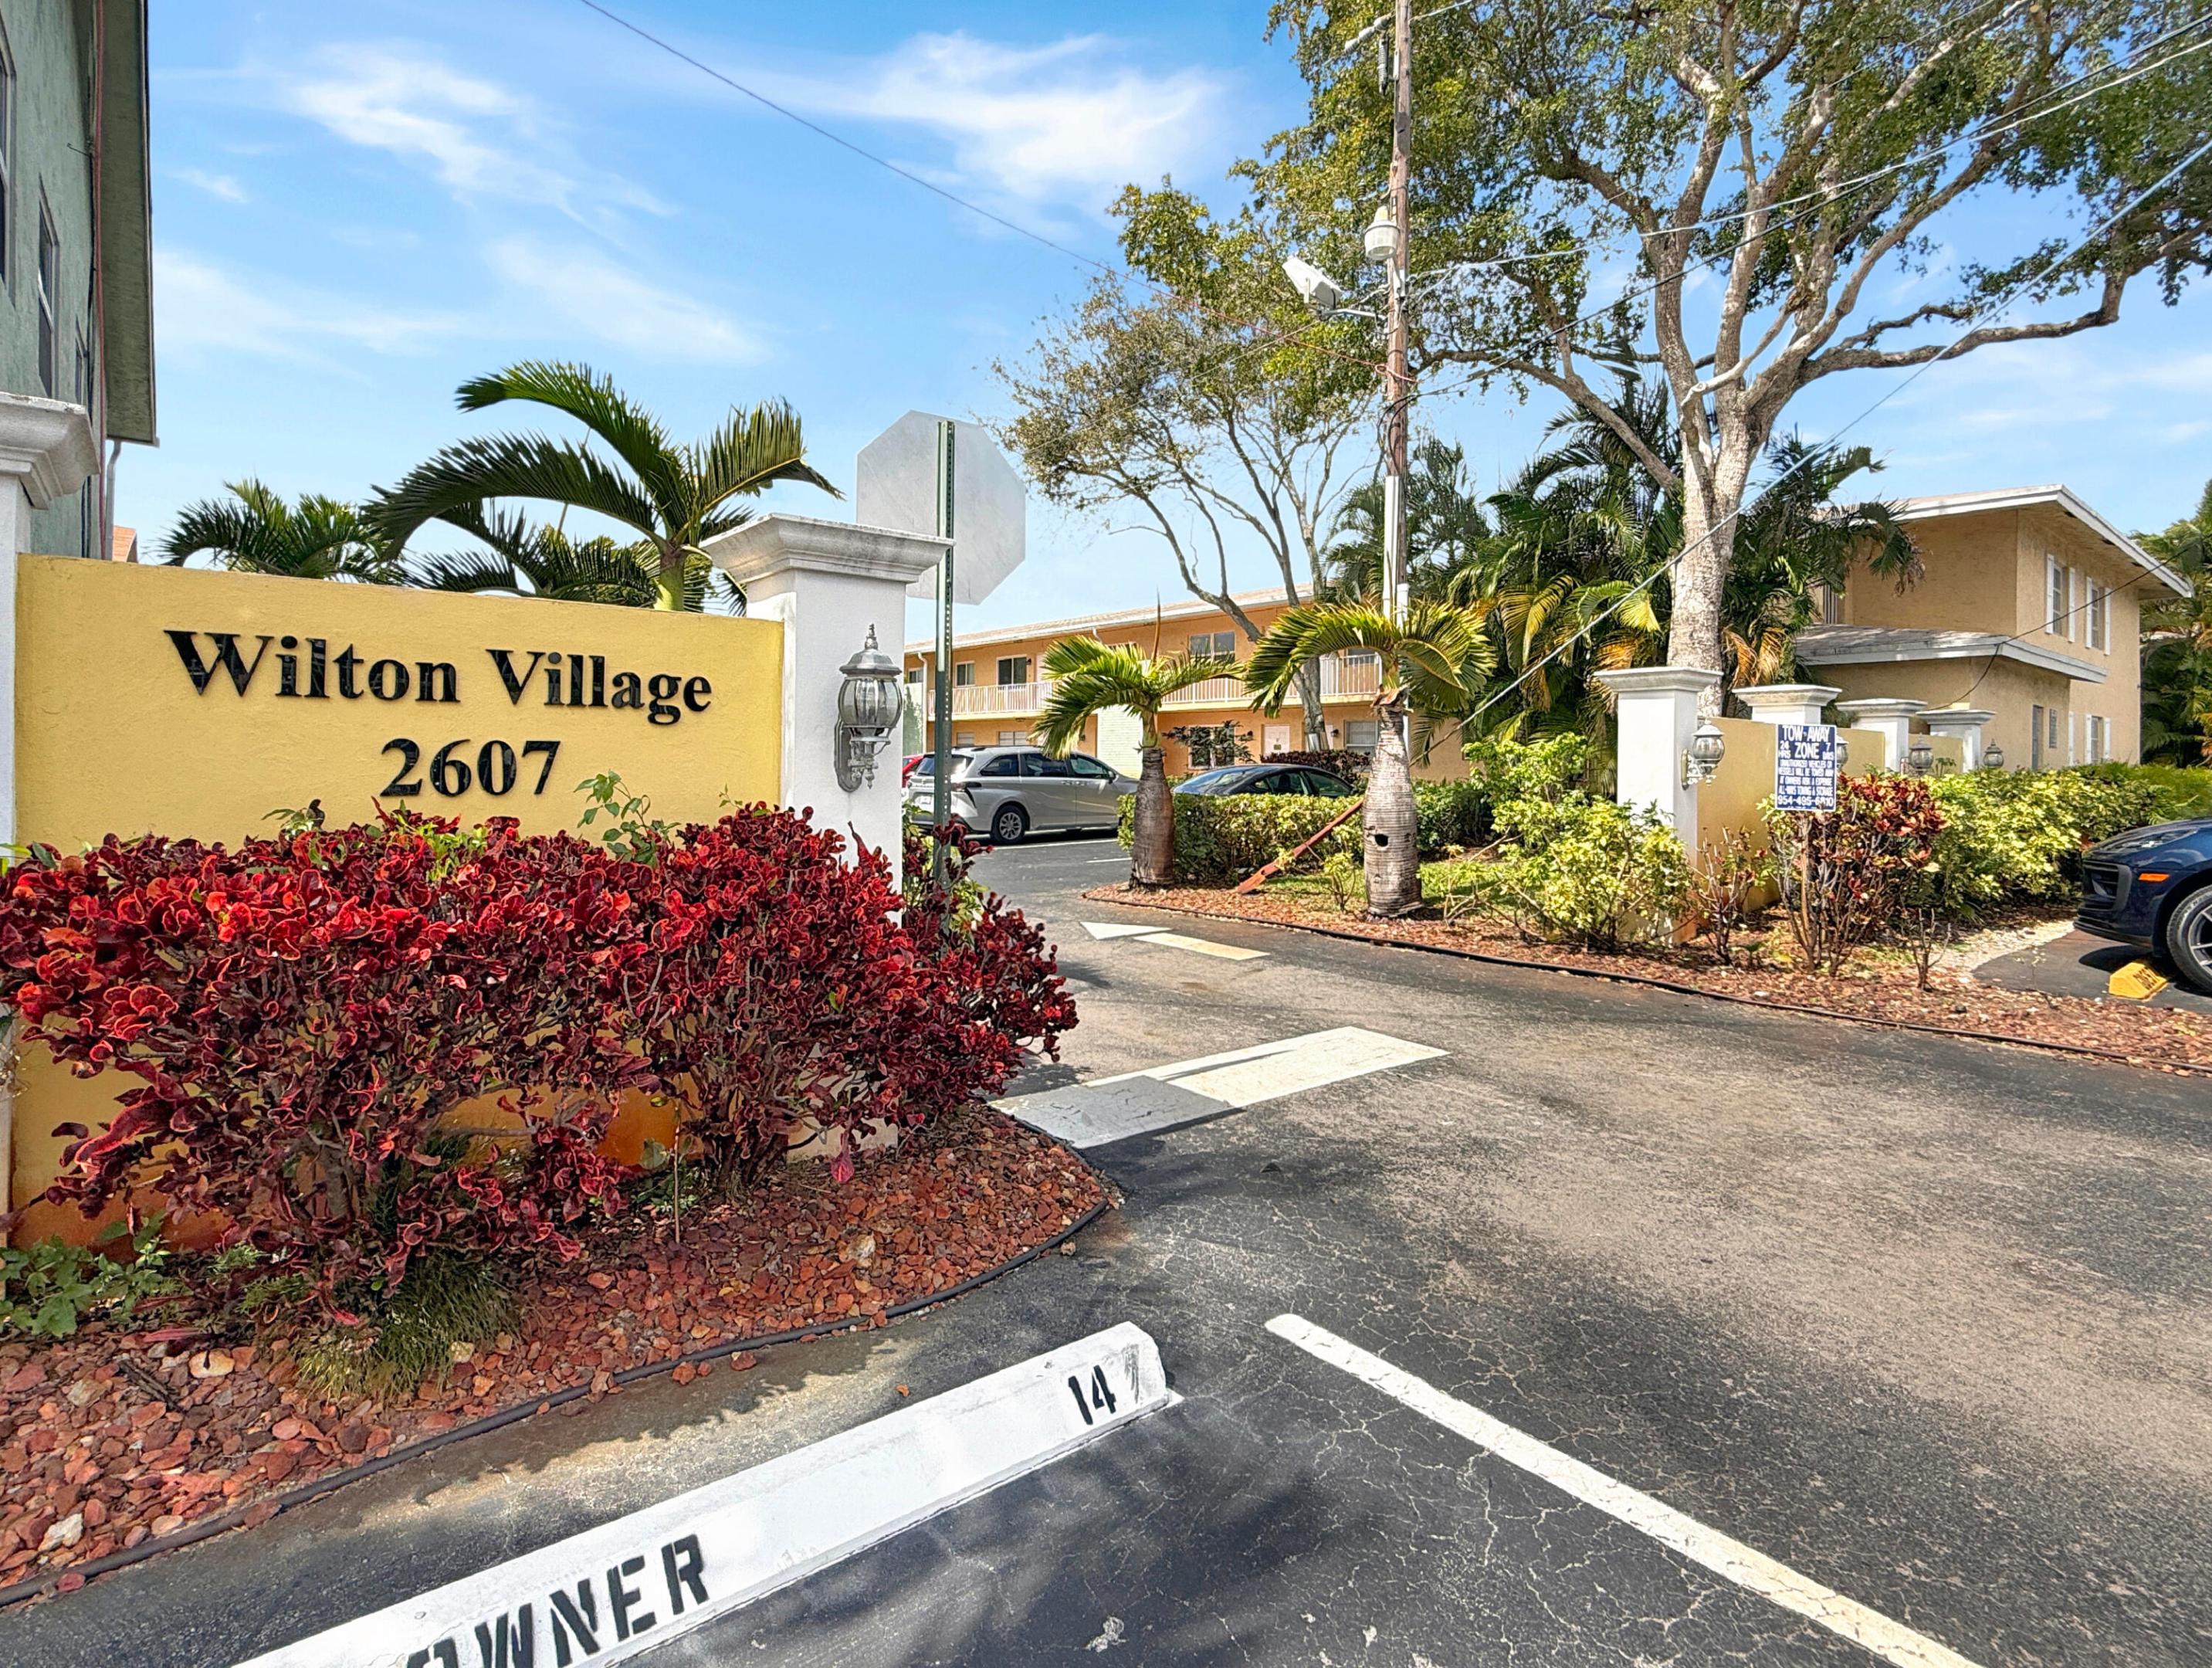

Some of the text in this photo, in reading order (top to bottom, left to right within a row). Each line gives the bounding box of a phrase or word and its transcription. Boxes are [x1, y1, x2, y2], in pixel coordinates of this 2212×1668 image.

[163, 629, 713, 727] Wilton Village
[1780, 741, 1790, 750] 24
[1794, 742, 1820, 759] ZONE
[1826, 743, 1831, 751] 7
[379, 738, 561, 798] 2607
[1068, 1365, 1116, 1426] 14
